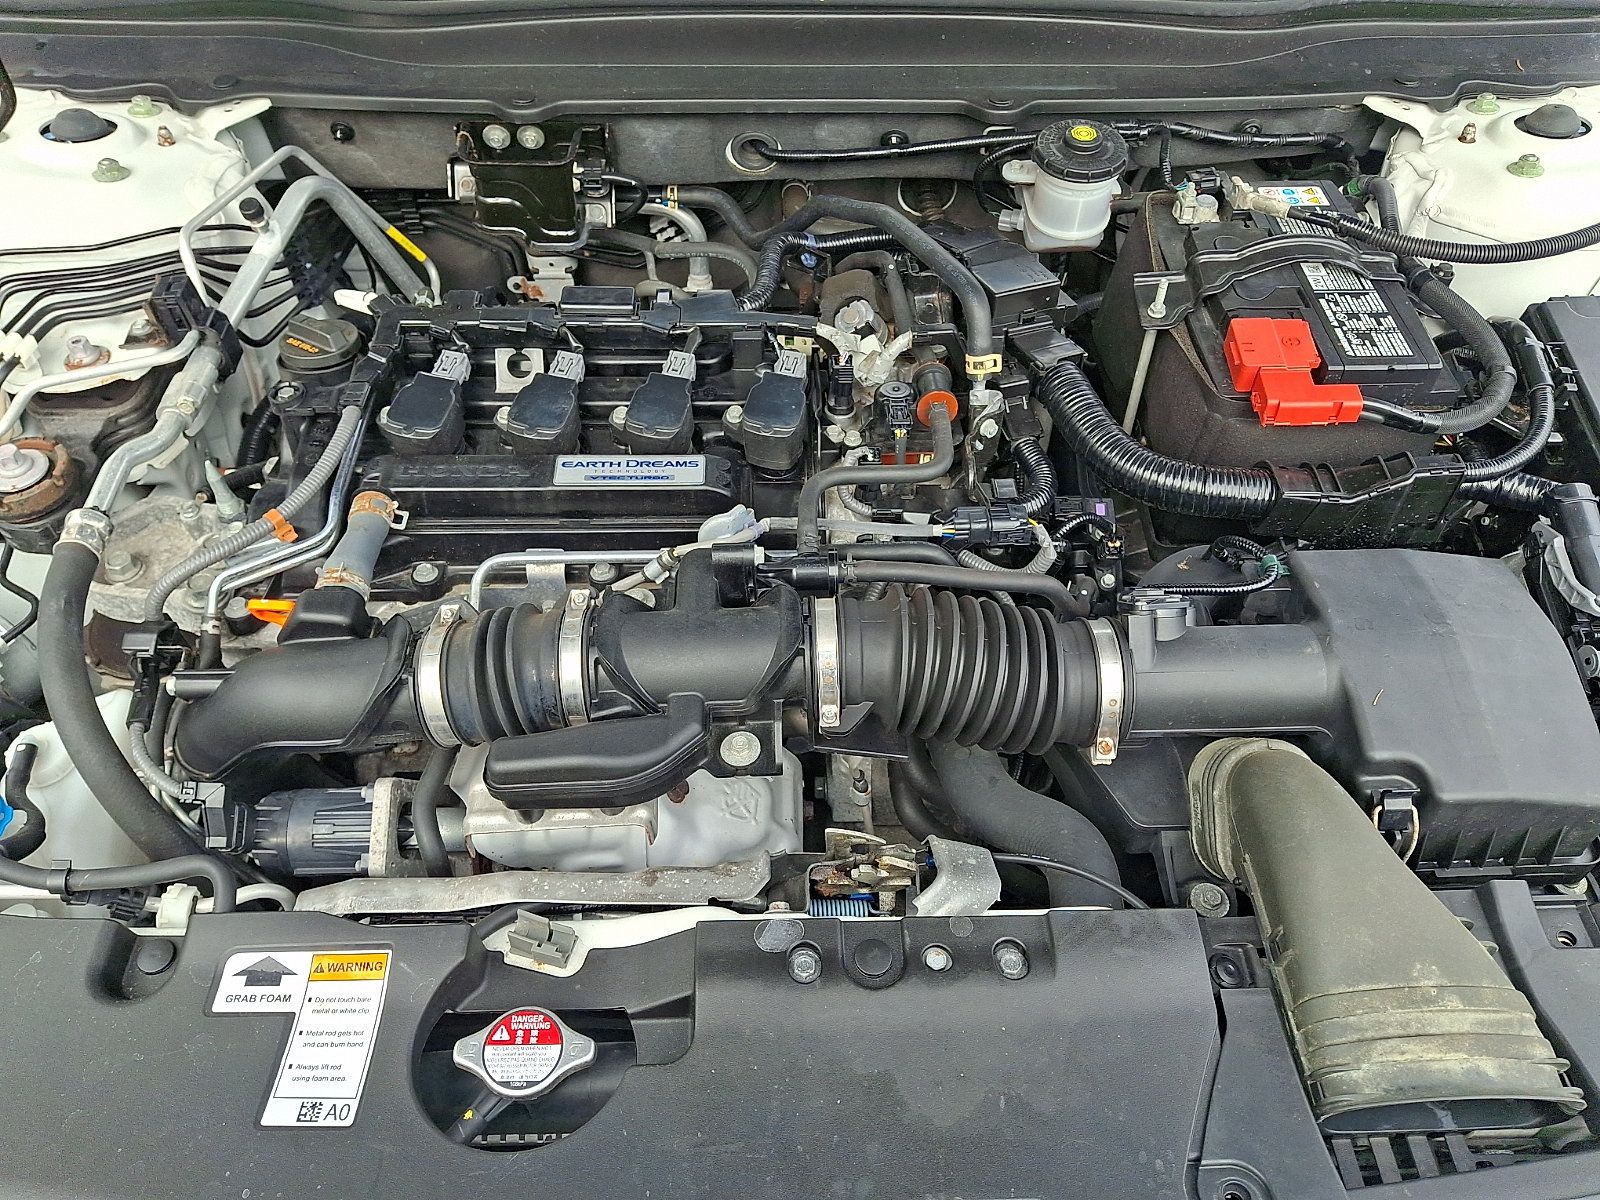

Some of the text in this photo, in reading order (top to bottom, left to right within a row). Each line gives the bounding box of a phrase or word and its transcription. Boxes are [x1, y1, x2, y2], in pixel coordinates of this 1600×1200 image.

[626, 459, 699, 468] DREAMS
[400, 465, 530, 477] HONDA
[327, 961, 383, 973] WARNING
[225, 994, 292, 1003] GRAB FOAM
[511, 1015, 544, 1023] DANGER
[511, 1022, 551, 1030] WARNUNG
[292, 1075, 311, 1083] using
[323, 1103, 350, 1121] A0
